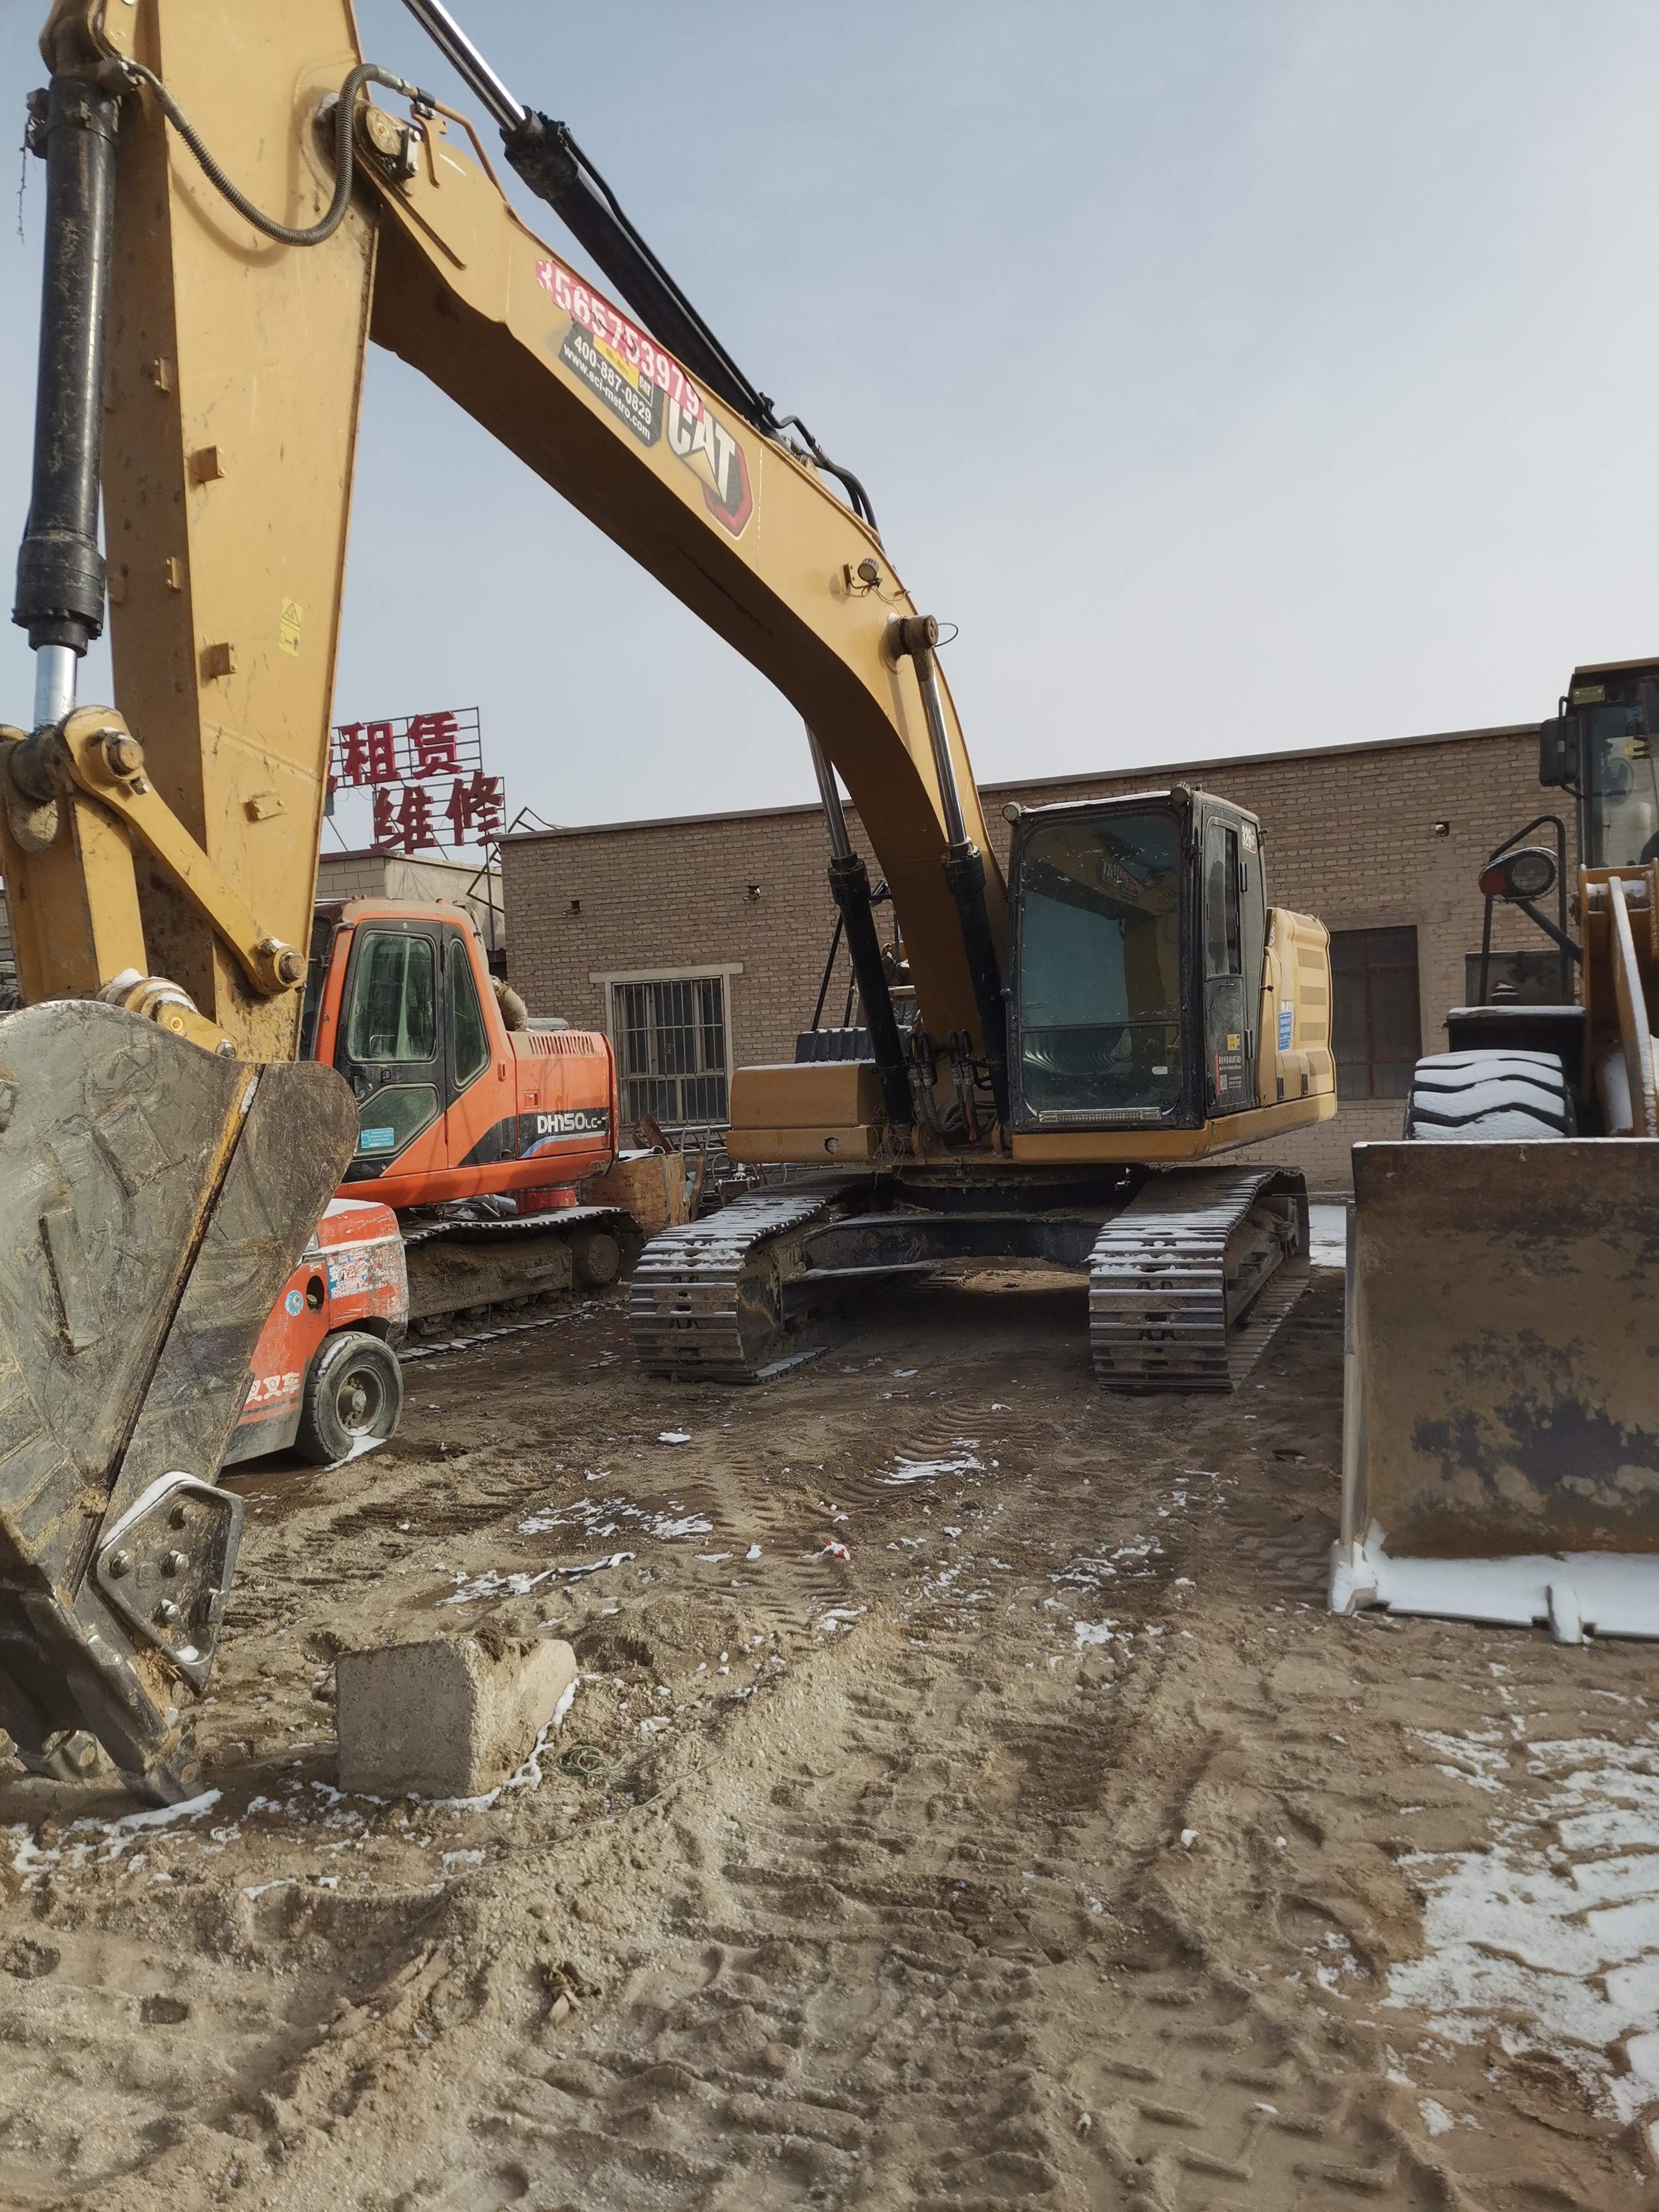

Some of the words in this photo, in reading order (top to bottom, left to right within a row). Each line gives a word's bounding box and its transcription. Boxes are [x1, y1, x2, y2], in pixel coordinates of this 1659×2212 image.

[564, 343, 650, 441] www.eci-metro.com
[574, 336, 651, 425] 400-887-0829
[669, 397, 735, 503] CAT
[326, 711, 464, 793] 租赁
[369, 771, 504, 854] 维修
